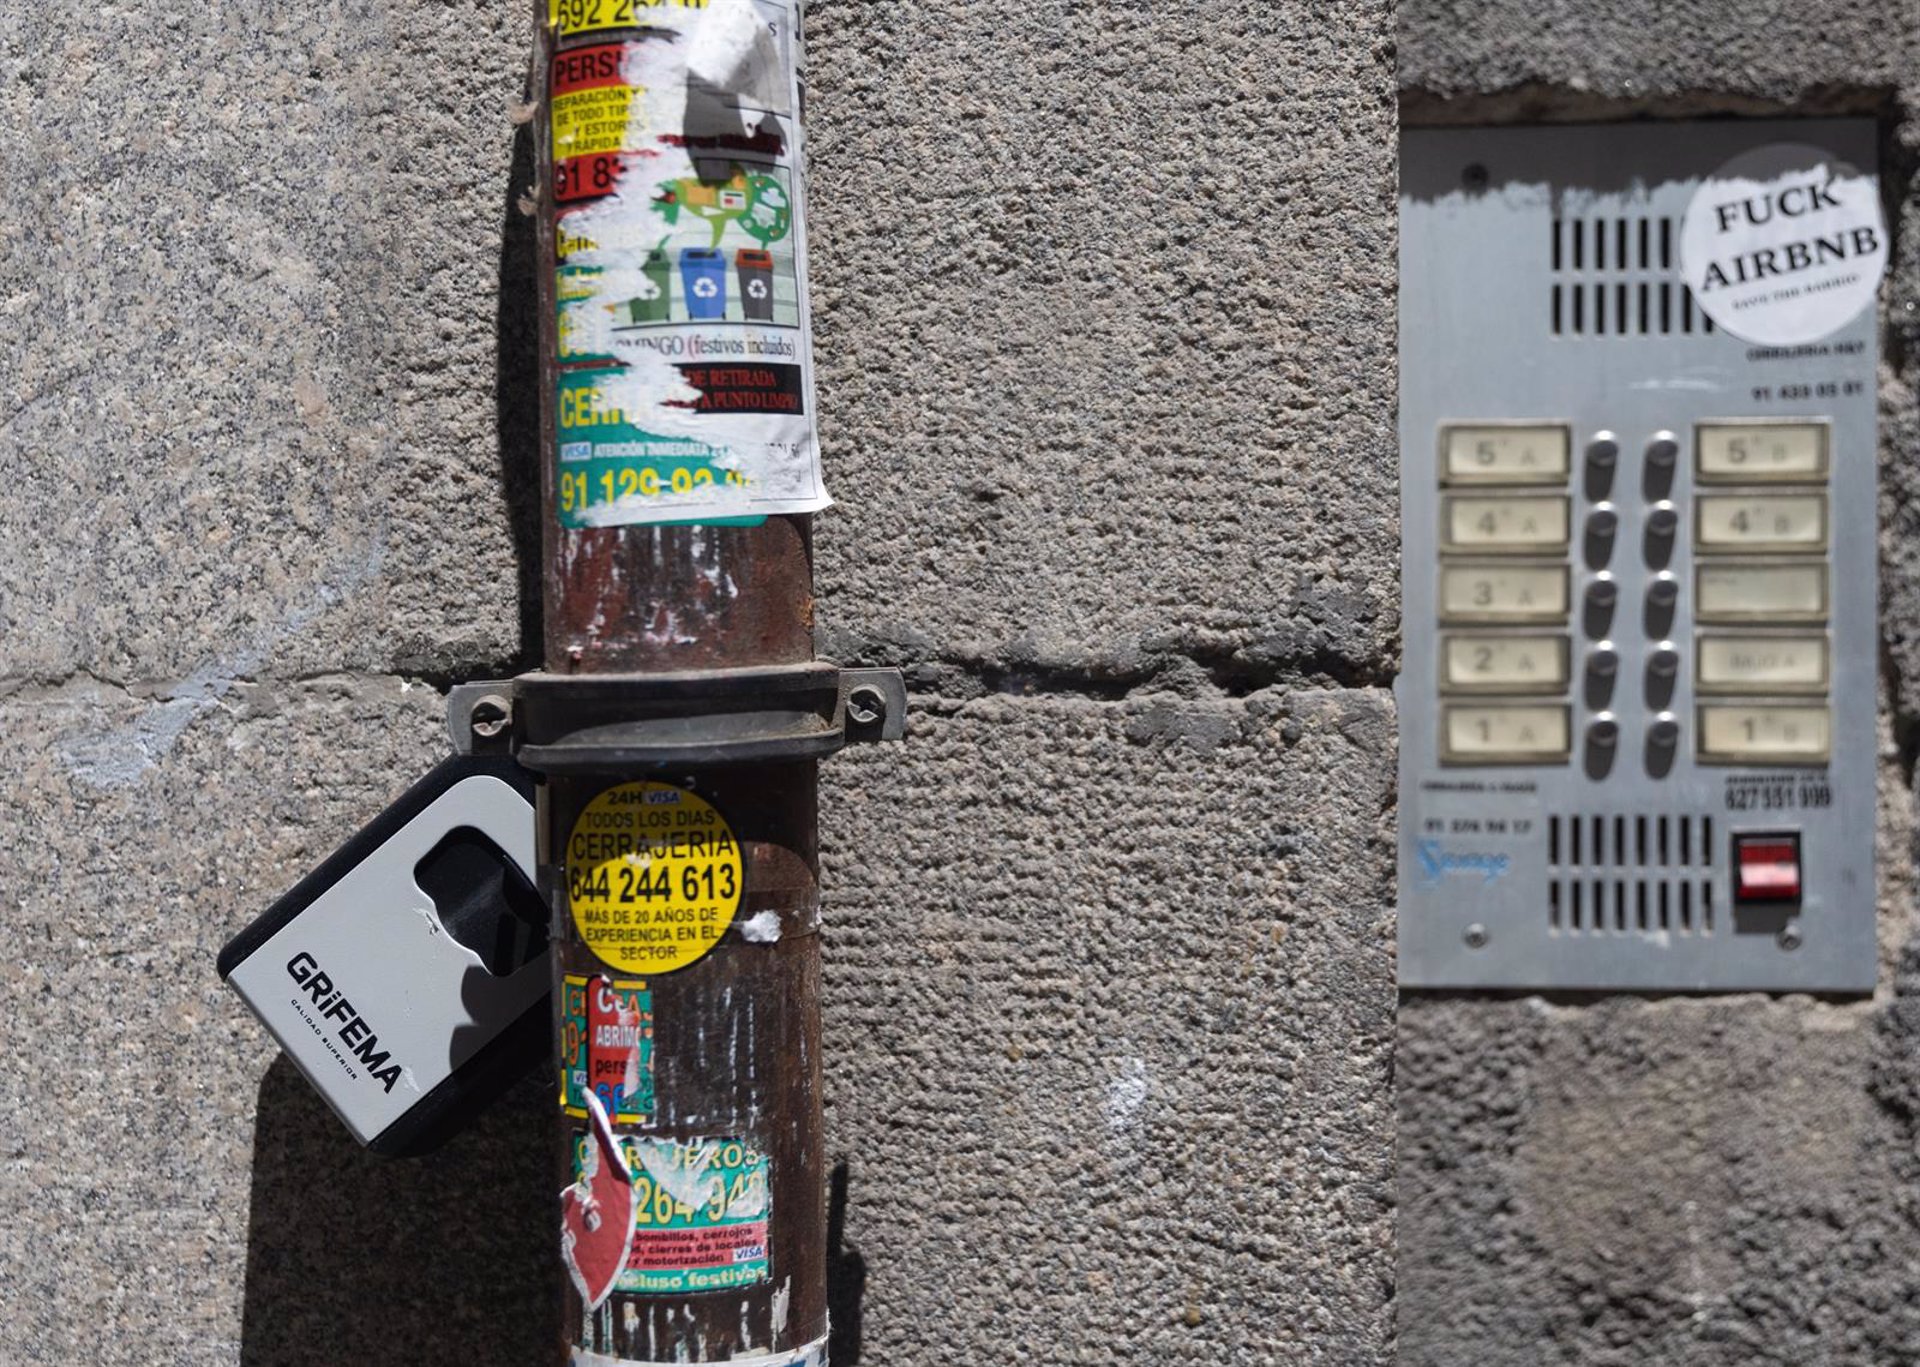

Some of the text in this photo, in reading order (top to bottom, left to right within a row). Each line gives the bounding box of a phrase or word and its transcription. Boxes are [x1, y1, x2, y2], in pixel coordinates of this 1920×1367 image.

[573, 107, 604, 122] TODO
[1714, 176, 1842, 234] FUCK
[1701, 225, 1879, 293] AIRBNB
[561, 471, 588, 511] 91
[608, 791, 681, 805] 24H VISA
[586, 809, 715, 829] TODOS LOS DIAS
[572, 830, 735, 862] CERRAJERIA
[569, 863, 736, 904] 644 244 613
[613, 911, 630, 924] DE
[635, 911, 650, 924] 20
[653, 906, 696, 923] AÑOS
[700, 907, 719, 922] DE
[586, 925, 719, 942] EXPERIENCIA EN EL
[619, 946, 678, 960] SECTOR
[290, 999, 358, 1081] CALIDAD SUPERIOR
[696, 1242, 711, 1253] de
[735, 1246, 763, 1260] VISA
[687, 1264, 768, 1287] festivos
